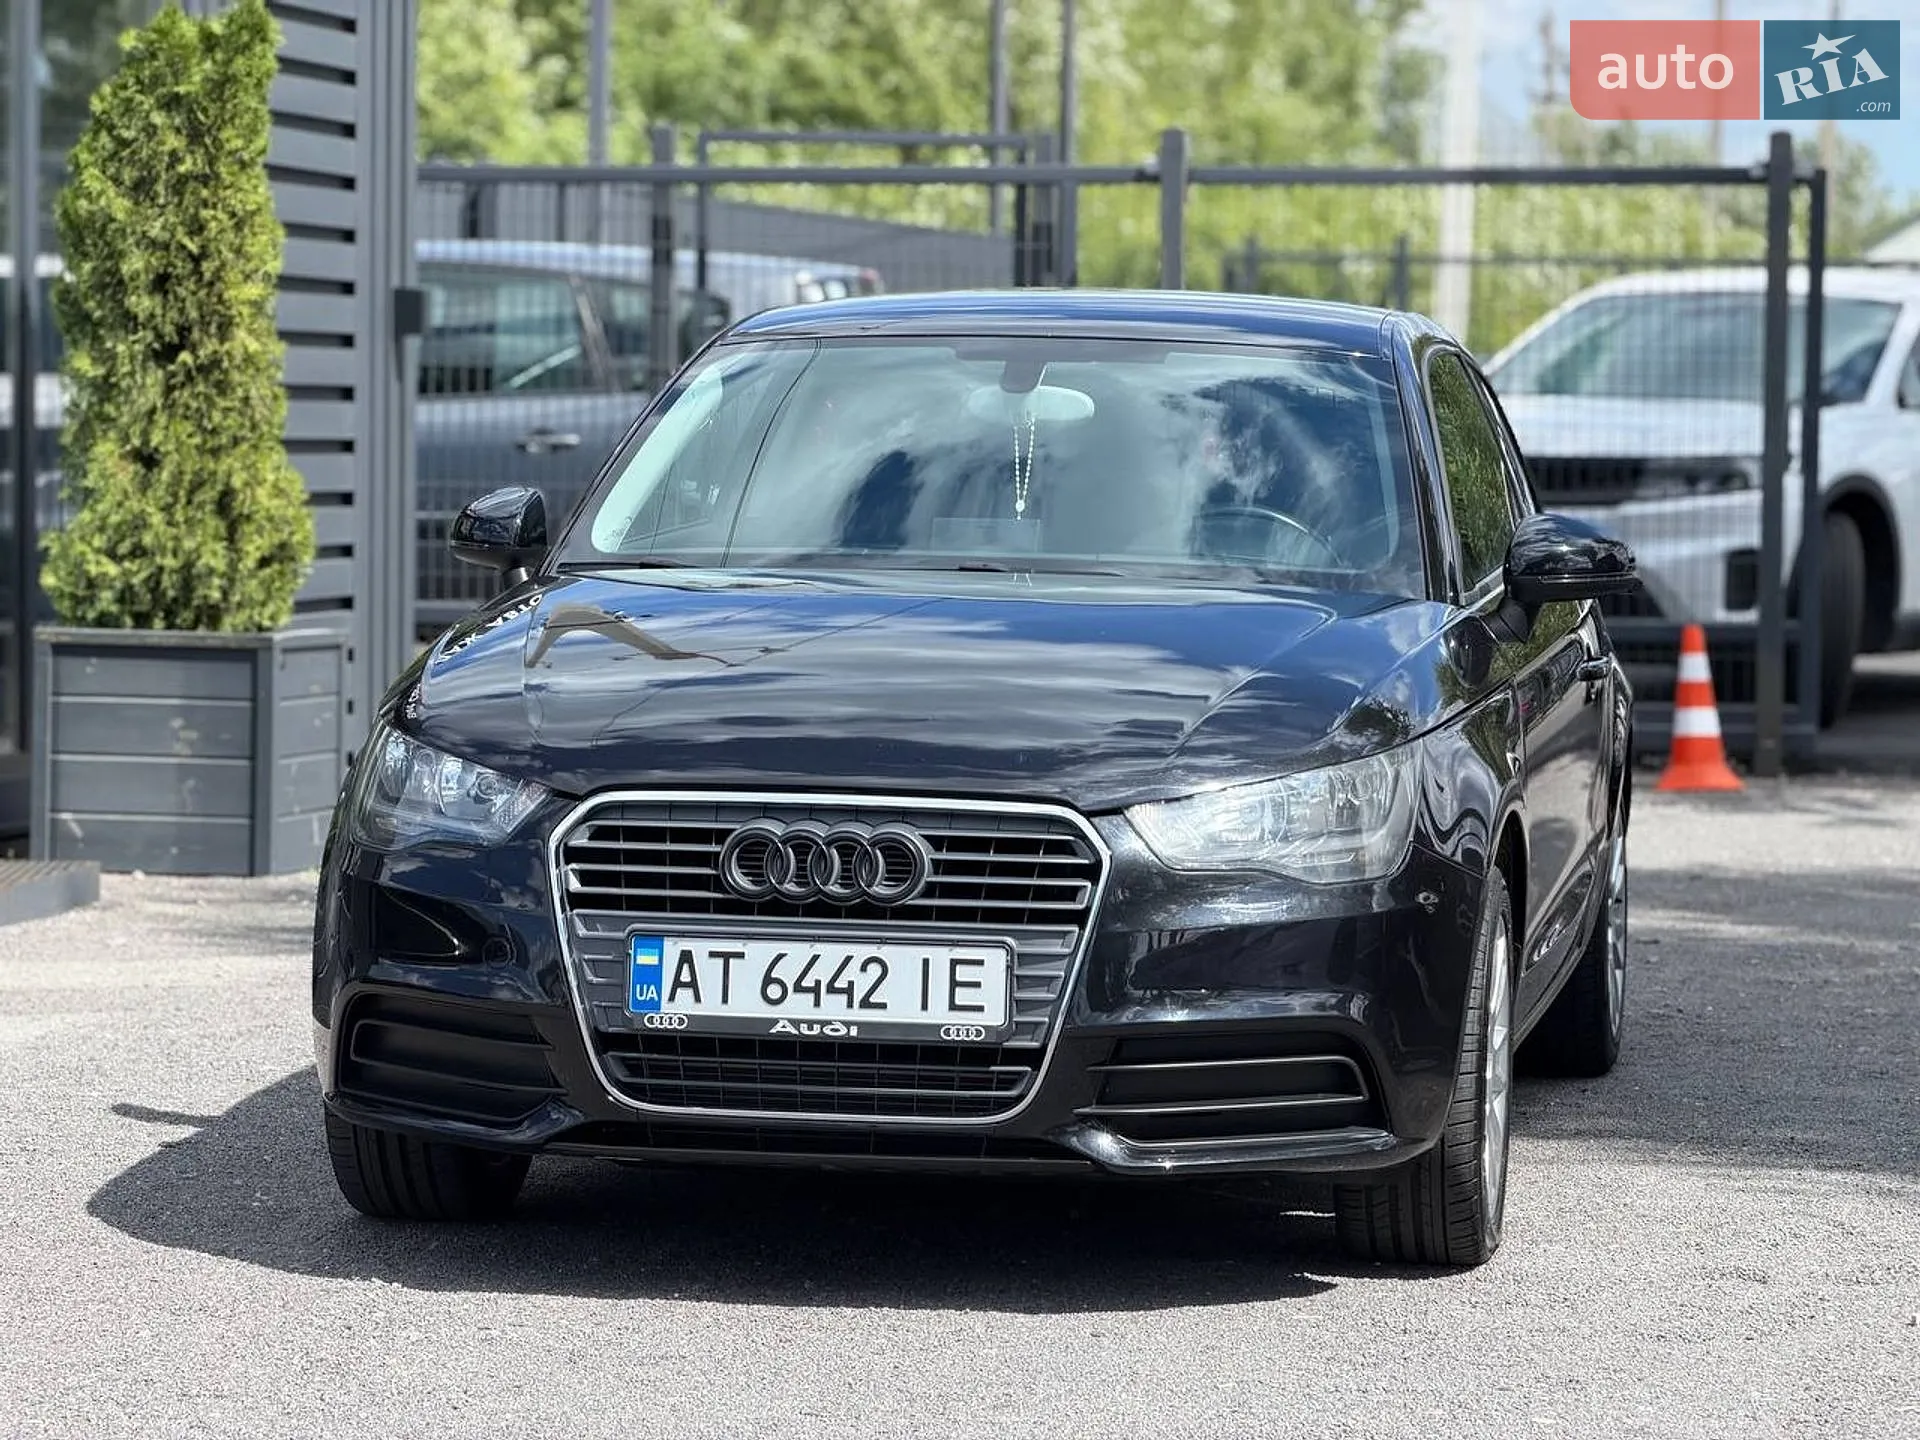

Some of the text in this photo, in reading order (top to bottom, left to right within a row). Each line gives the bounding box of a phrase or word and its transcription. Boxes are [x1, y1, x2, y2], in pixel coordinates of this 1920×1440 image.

[668, 949, 985, 1013] AT 6442 IE
[636, 984, 659, 1001] UA
[768, 1018, 859, 1037] Audi
